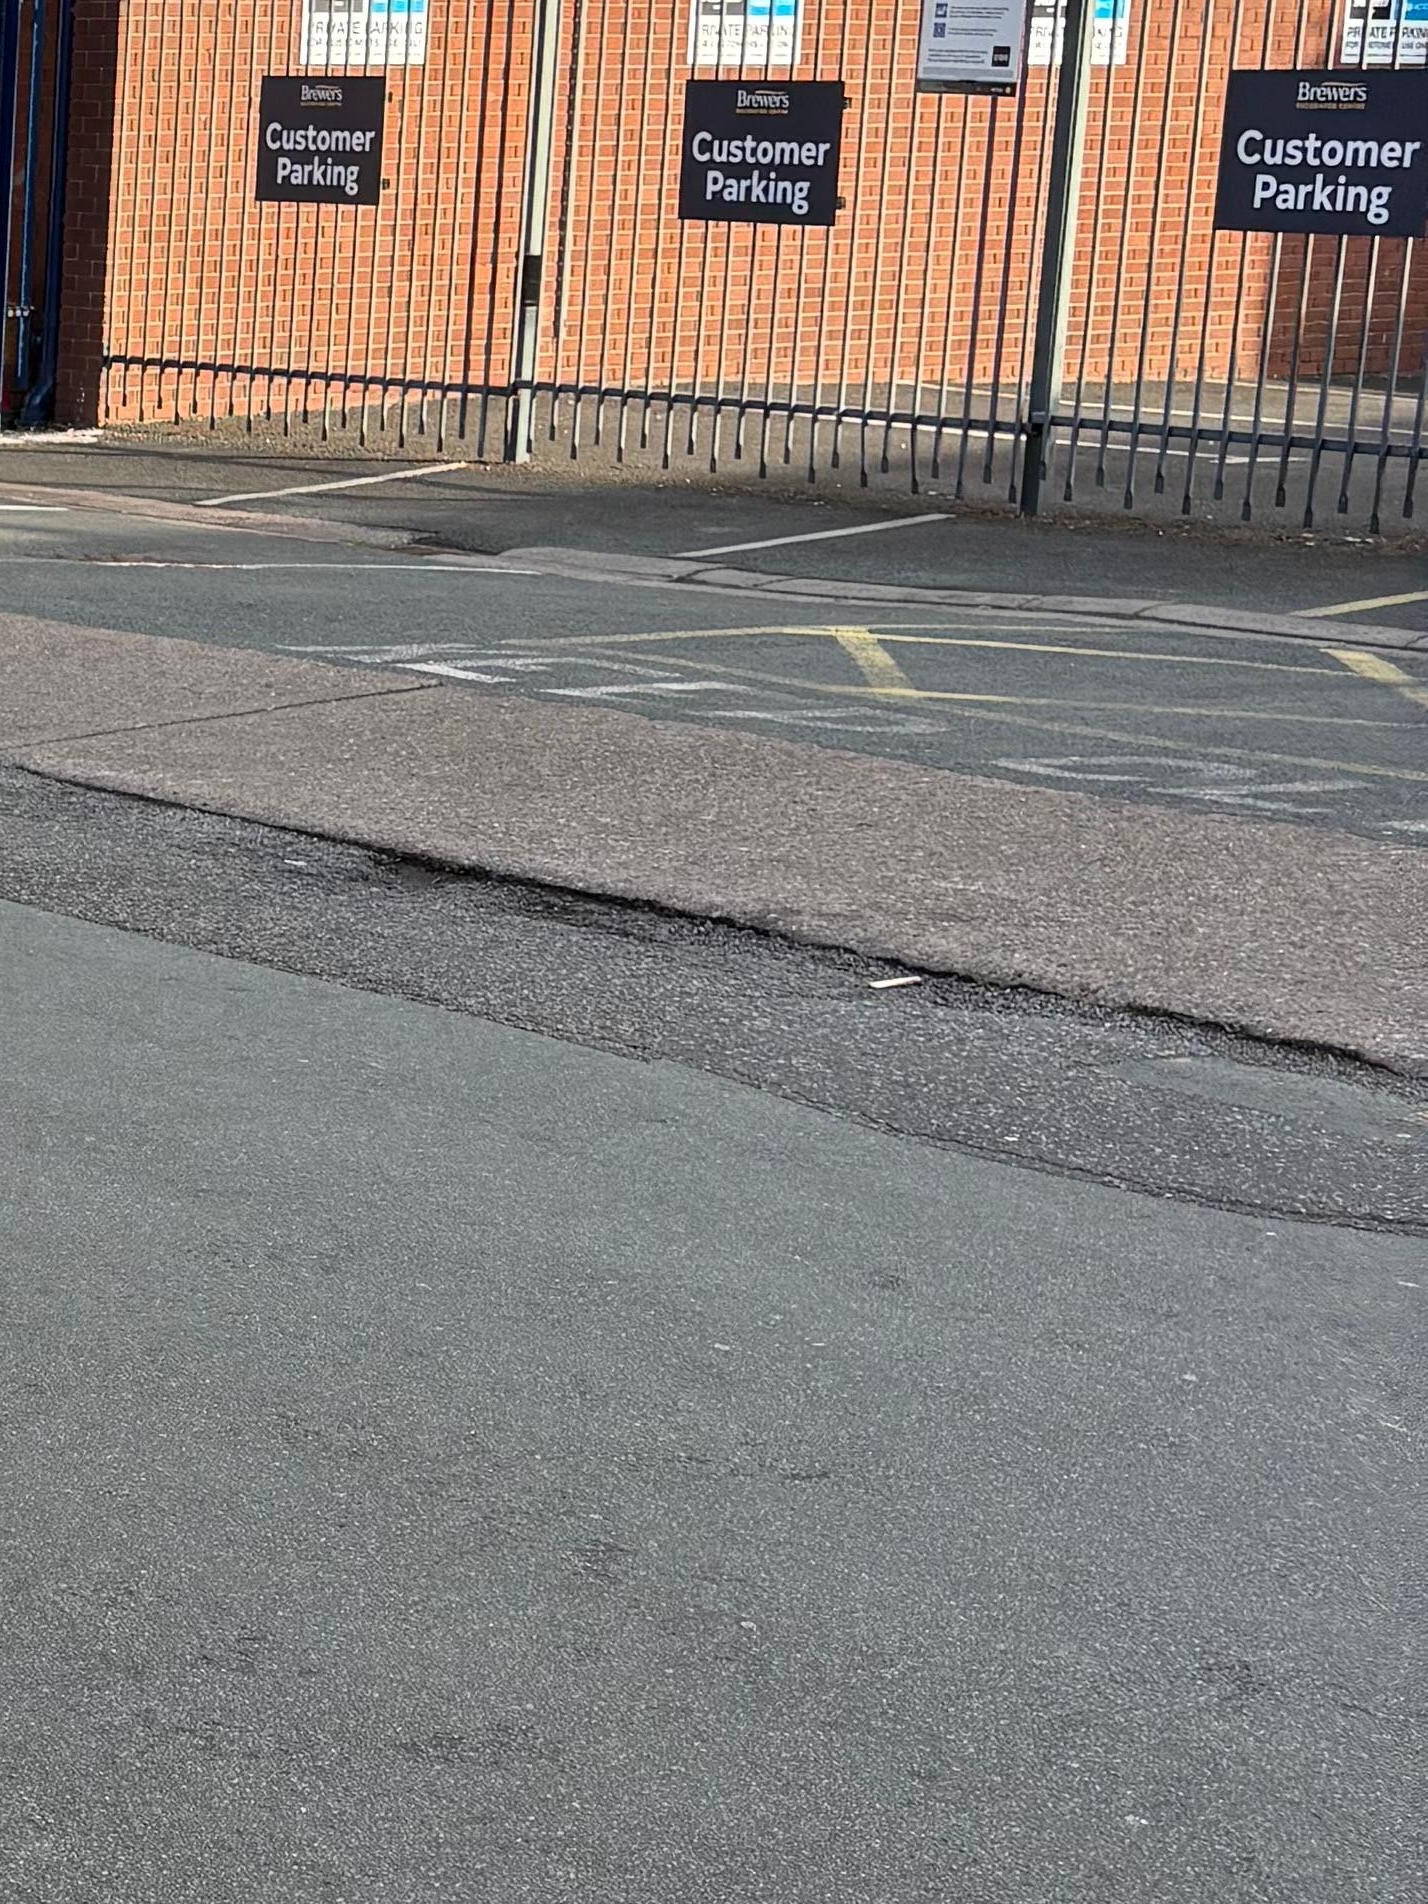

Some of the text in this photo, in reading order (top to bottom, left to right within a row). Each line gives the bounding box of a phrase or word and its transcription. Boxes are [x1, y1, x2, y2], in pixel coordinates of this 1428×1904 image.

[301, 85, 343, 101] Brewers
[737, 90, 790, 108] Brewers
[1297, 81, 1367, 102] Brewers
[265, 122, 376, 152] Customer
[692, 131, 831, 166] Customer
[1237, 129, 1421, 168] Customer
[276, 156, 360, 196] Parking
[705, 169, 810, 215] Parking
[1253, 173, 1393, 225] Parking
